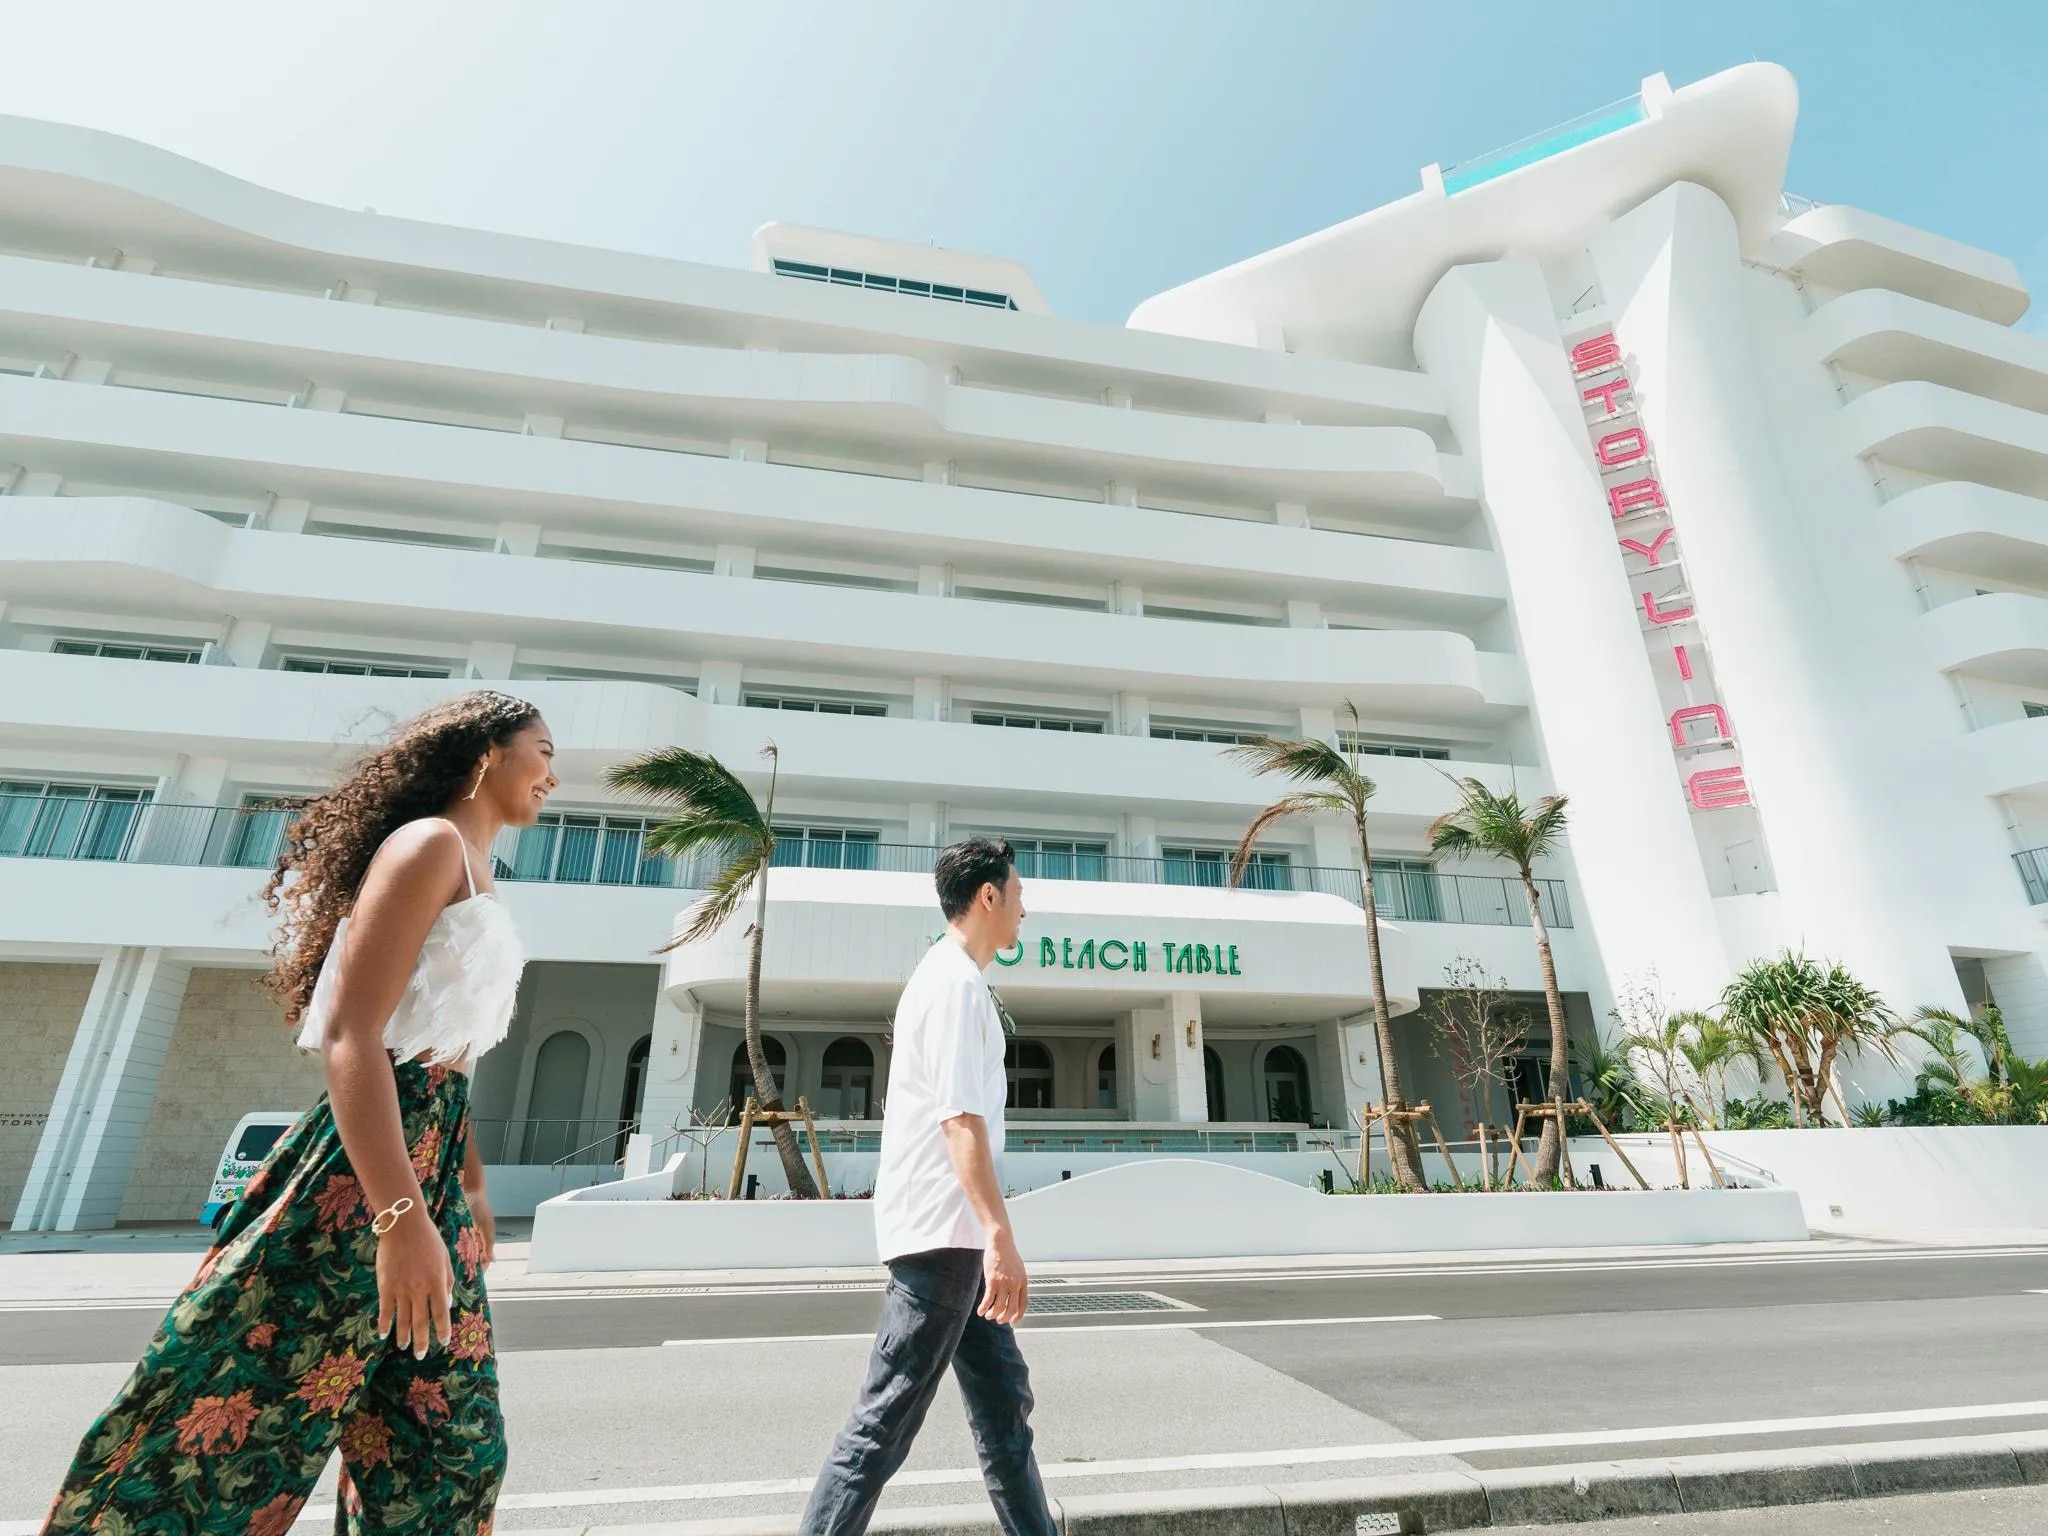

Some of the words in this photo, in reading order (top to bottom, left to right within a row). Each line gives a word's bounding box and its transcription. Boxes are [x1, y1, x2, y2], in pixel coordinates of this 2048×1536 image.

[1570, 333, 1750, 809] STORYLINE
[1040, 936, 1147, 972] BEACH
[1162, 942, 1242, 976] TABLE
